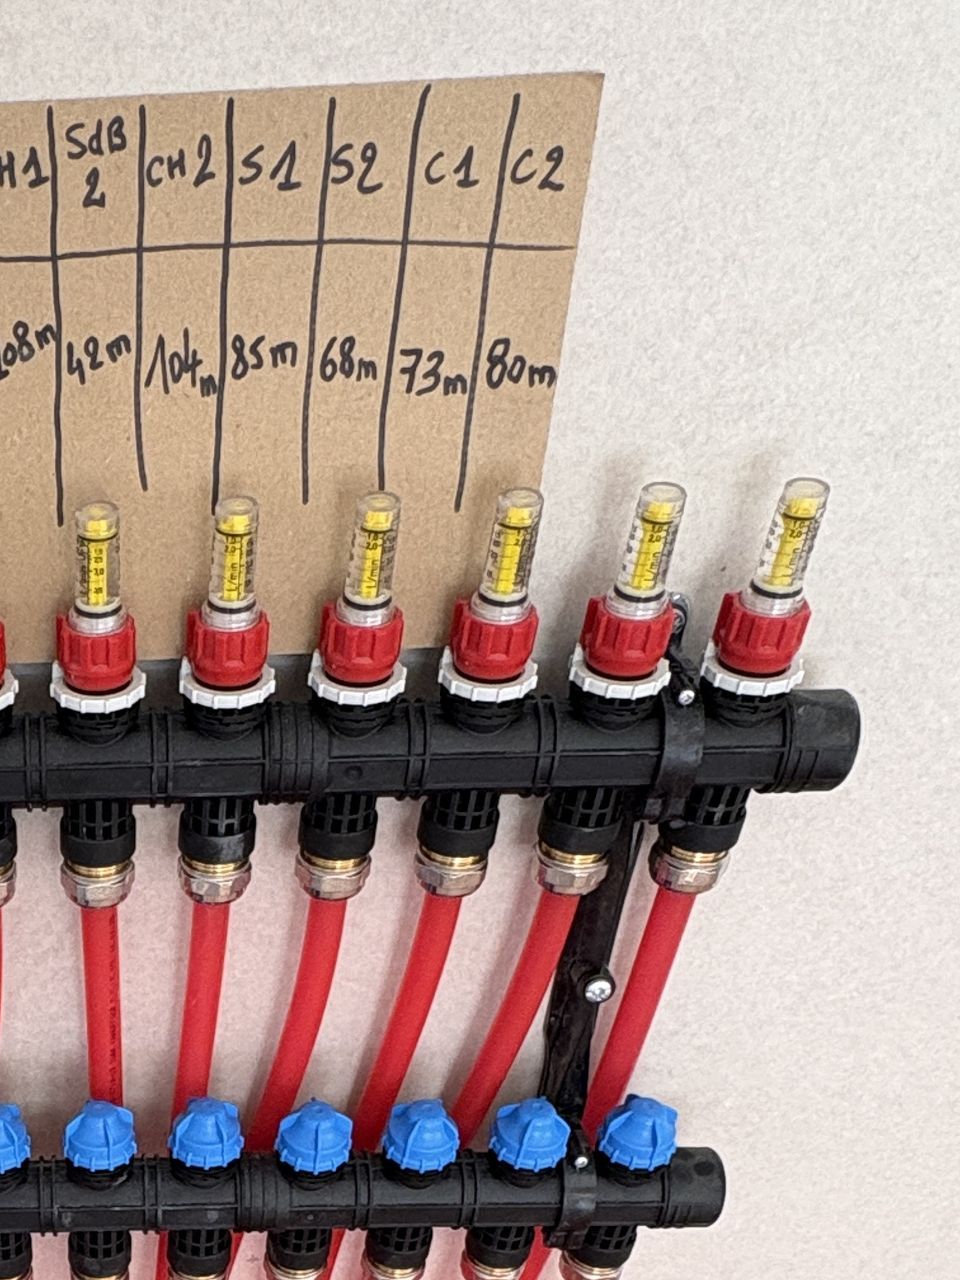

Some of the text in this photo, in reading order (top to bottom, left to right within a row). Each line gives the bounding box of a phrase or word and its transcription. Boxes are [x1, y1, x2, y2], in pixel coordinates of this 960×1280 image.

[65, 115, 127, 160] SdB
[82, 166, 106, 208] 2
[67, 334, 132, 385] 42m
[144, 327, 218, 398] 104m
[231, 334, 298, 381] 85m
[320, 336, 378, 382] 68m
[400, 348, 468, 397] 73m
[486, 338, 557, 390] 80m
